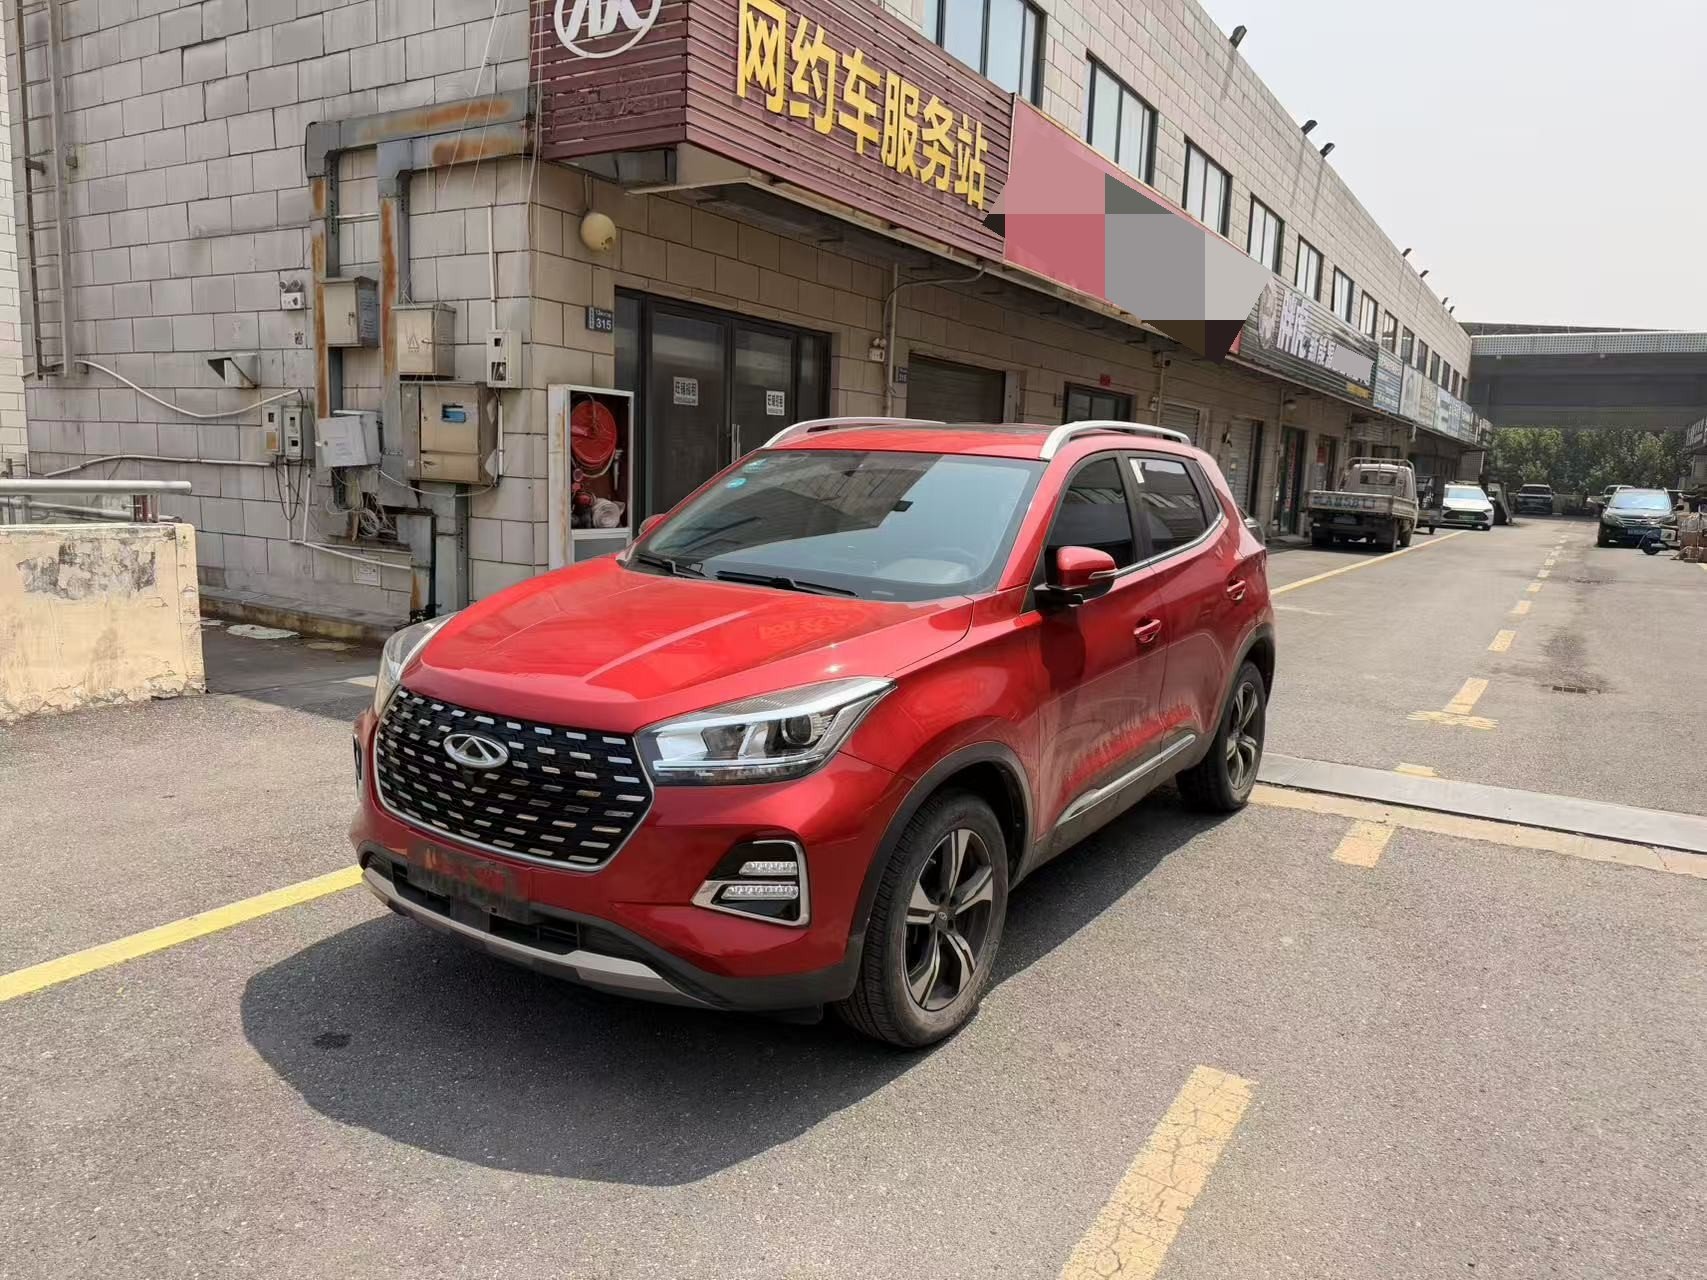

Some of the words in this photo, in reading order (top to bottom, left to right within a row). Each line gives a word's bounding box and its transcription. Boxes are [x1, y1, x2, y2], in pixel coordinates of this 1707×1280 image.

[737, 0, 988, 210] 网约车服务站
[595, 318, 612, 330] 315
